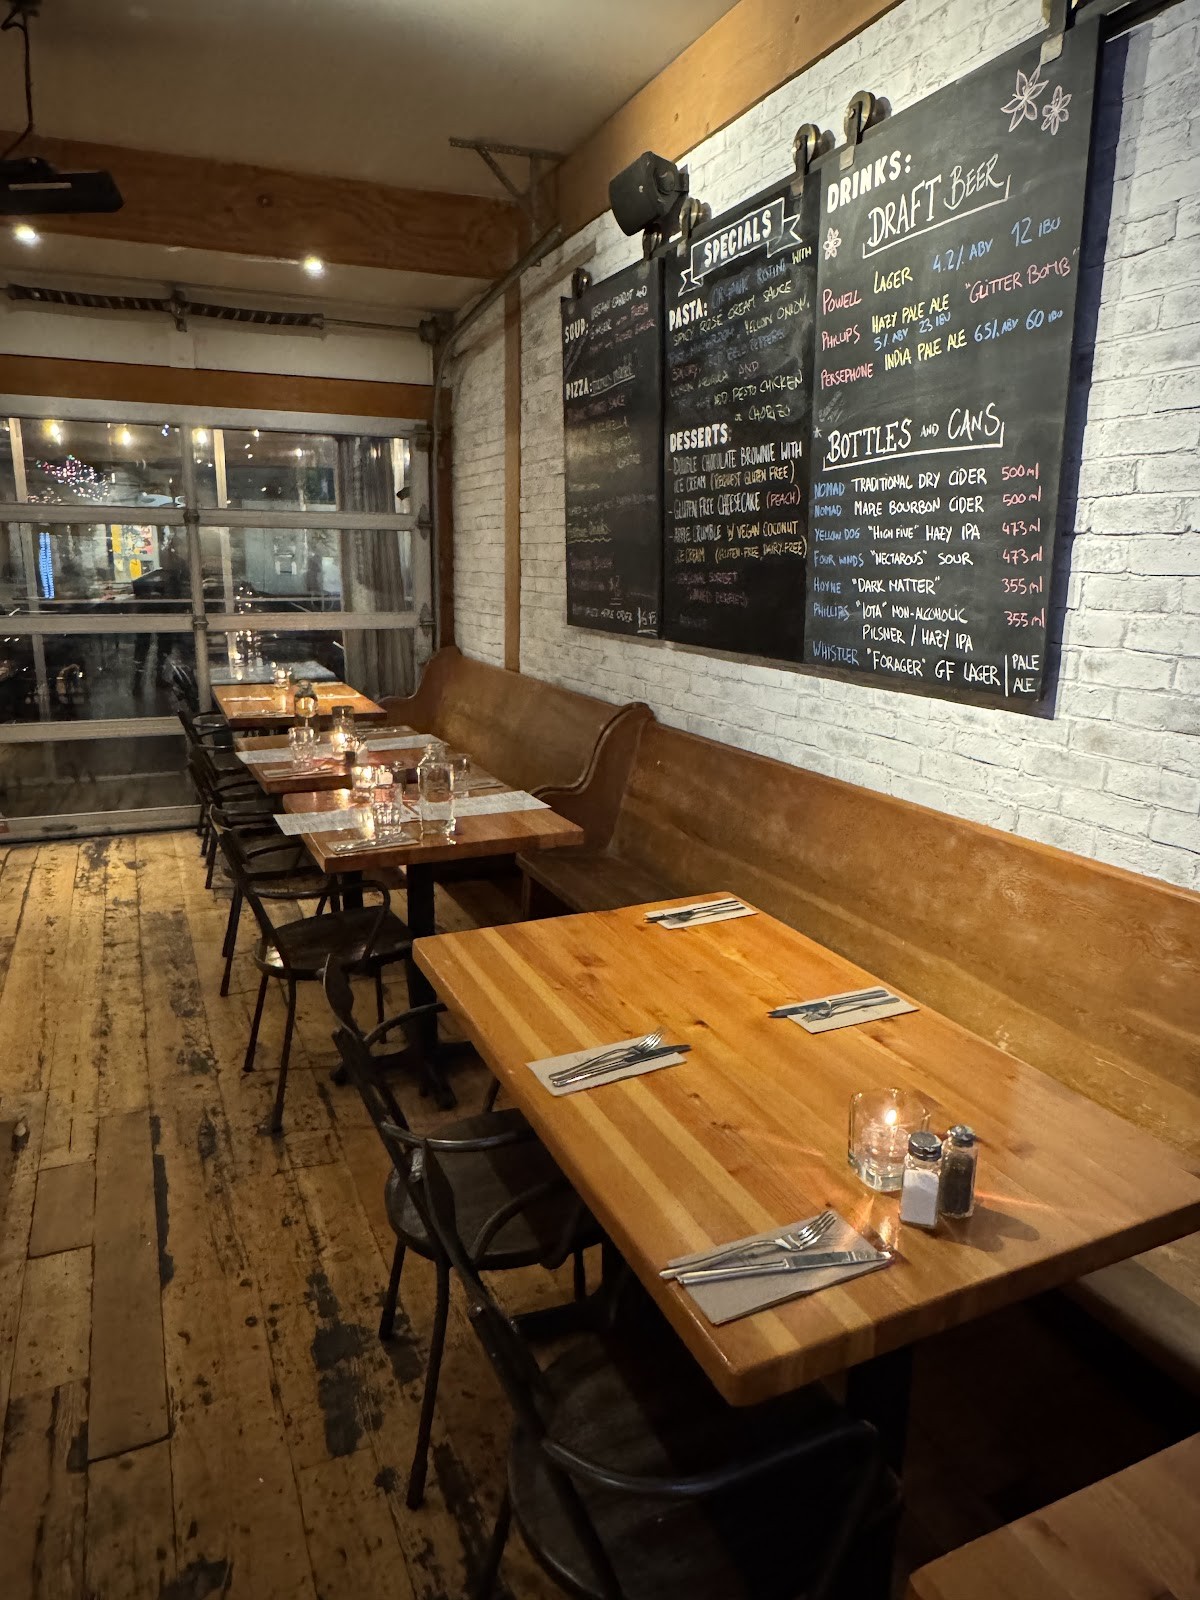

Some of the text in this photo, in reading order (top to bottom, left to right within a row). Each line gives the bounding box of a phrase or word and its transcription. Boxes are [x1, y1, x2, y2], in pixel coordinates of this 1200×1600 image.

[827, 150, 912, 214] DRINKS:
[866, 153, 1004, 247] DRAFT BEER
[704, 209, 772, 268] SPECIALS
[792, 246, 812, 265] WITH
[873, 266, 913, 294] LAGER
[969, 238, 994, 261] ABV
[1011, 216, 1033, 247] 12
[1038, 216, 1062, 238] IBU
[727, 295, 756, 320] CREAM
[762, 280, 793, 303] SAUCE
[822, 288, 862, 316] POWELL
[871, 311, 898, 334] HAZY
[901, 300, 925, 324] PALE
[929, 294, 950, 315] ALE
[669, 298, 708, 332] PASTA:
[892, 327, 909, 344] ABV
[918, 318, 934, 334] 23
[935, 311, 951, 327] IBU
[820, 362, 874, 391] PERSEPHONE
[884, 347, 912, 371] INDIA
[917, 338, 942, 361] PALE
[947, 329, 968, 351] ALE
[1001, 318, 1019, 334] ABV
[1025, 309, 1044, 330] 60
[1048, 310, 1064, 324] IBU
[759, 369, 804, 393] CHICKEN
[826, 402, 1001, 463] BOTTLES AND CANS
[740, 442, 776, 466] BROWNIE
[780, 440, 803, 461] WITH
[769, 460, 796, 484] FREE)
[814, 482, 845, 498] NOMAD
[851, 473, 913, 493] TRADITIONAL
[918, 471, 942, 489] DRY
[949, 466, 988, 487] CIDER
[717, 492, 761, 517] CHEESECAKE
[766, 484, 802, 509] (PEACH)
[814, 504, 842, 518] NOMAD
[854, 499, 883, 516] MAPLE
[889, 497, 941, 515] BOURBON
[949, 495, 985, 514] CIDER
[736, 521, 760, 540] VEGAN
[763, 520, 799, 537] COCONUT
[814, 528, 843, 542] YELLOW
[843, 527, 861, 540] DOG
[925, 525, 953, 543] HAZY
[962, 523, 981, 541] IPA
[813, 550, 837, 568] FOUR
[839, 552, 865, 569] WINDS
[938, 552, 974, 566] SOUR
[813, 576, 842, 593] HOYNE
[813, 602, 850, 621] PHILLIPS
[892, 604, 969, 624] NON-ALCOHOLIC
[862, 624, 906, 644] PILSNER
[921, 630, 950, 650] HAZY
[955, 632, 974, 653] IPA
[812, 640, 860, 666] WHISTLER
[935, 659, 956, 682] GF
[963, 662, 1001, 686] LAGER
[1011, 653, 1040, 671] PALE
[1013, 677, 1036, 693] ALE
